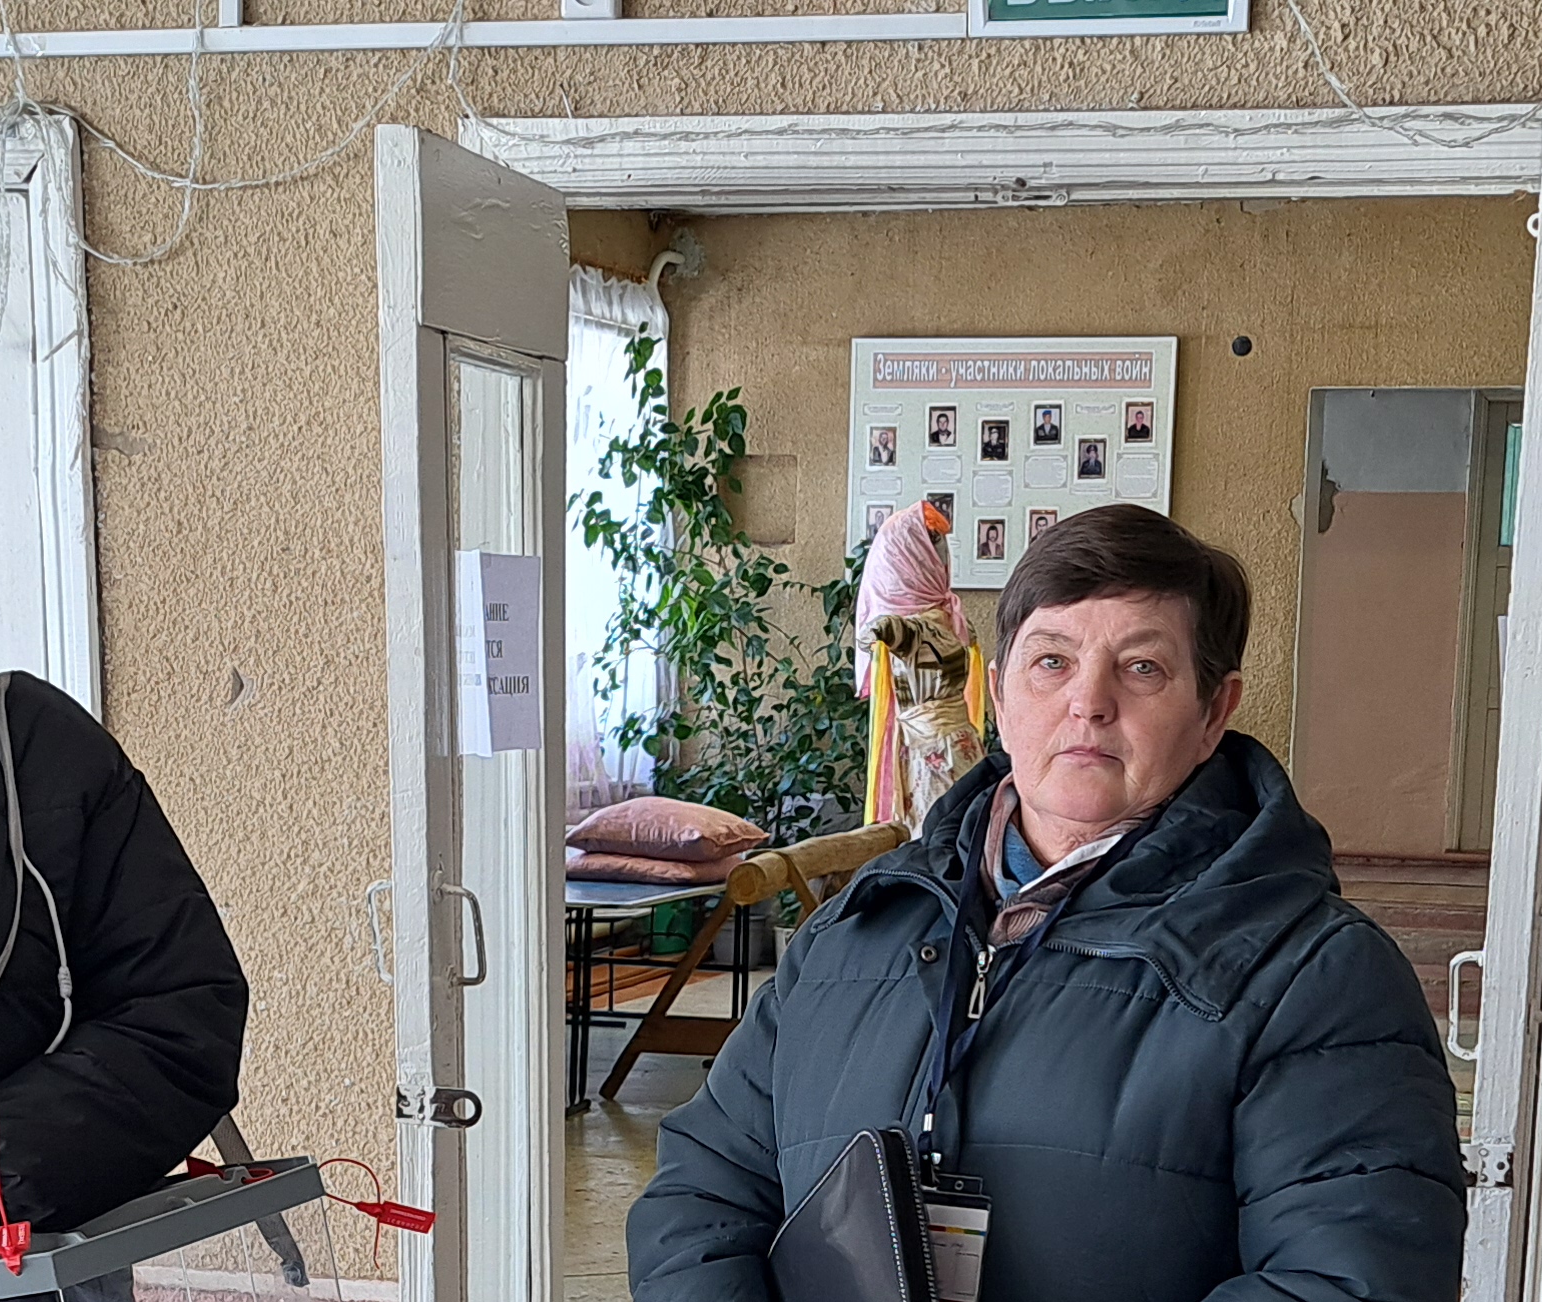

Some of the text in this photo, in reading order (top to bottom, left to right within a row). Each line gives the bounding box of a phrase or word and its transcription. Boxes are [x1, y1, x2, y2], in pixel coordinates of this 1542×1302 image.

[876, 353, 937, 382] Земляки
[949, 359, 1025, 388] участники
[1028, 359, 1111, 382] локальных
[1115, 353, 1151, 382] войн
